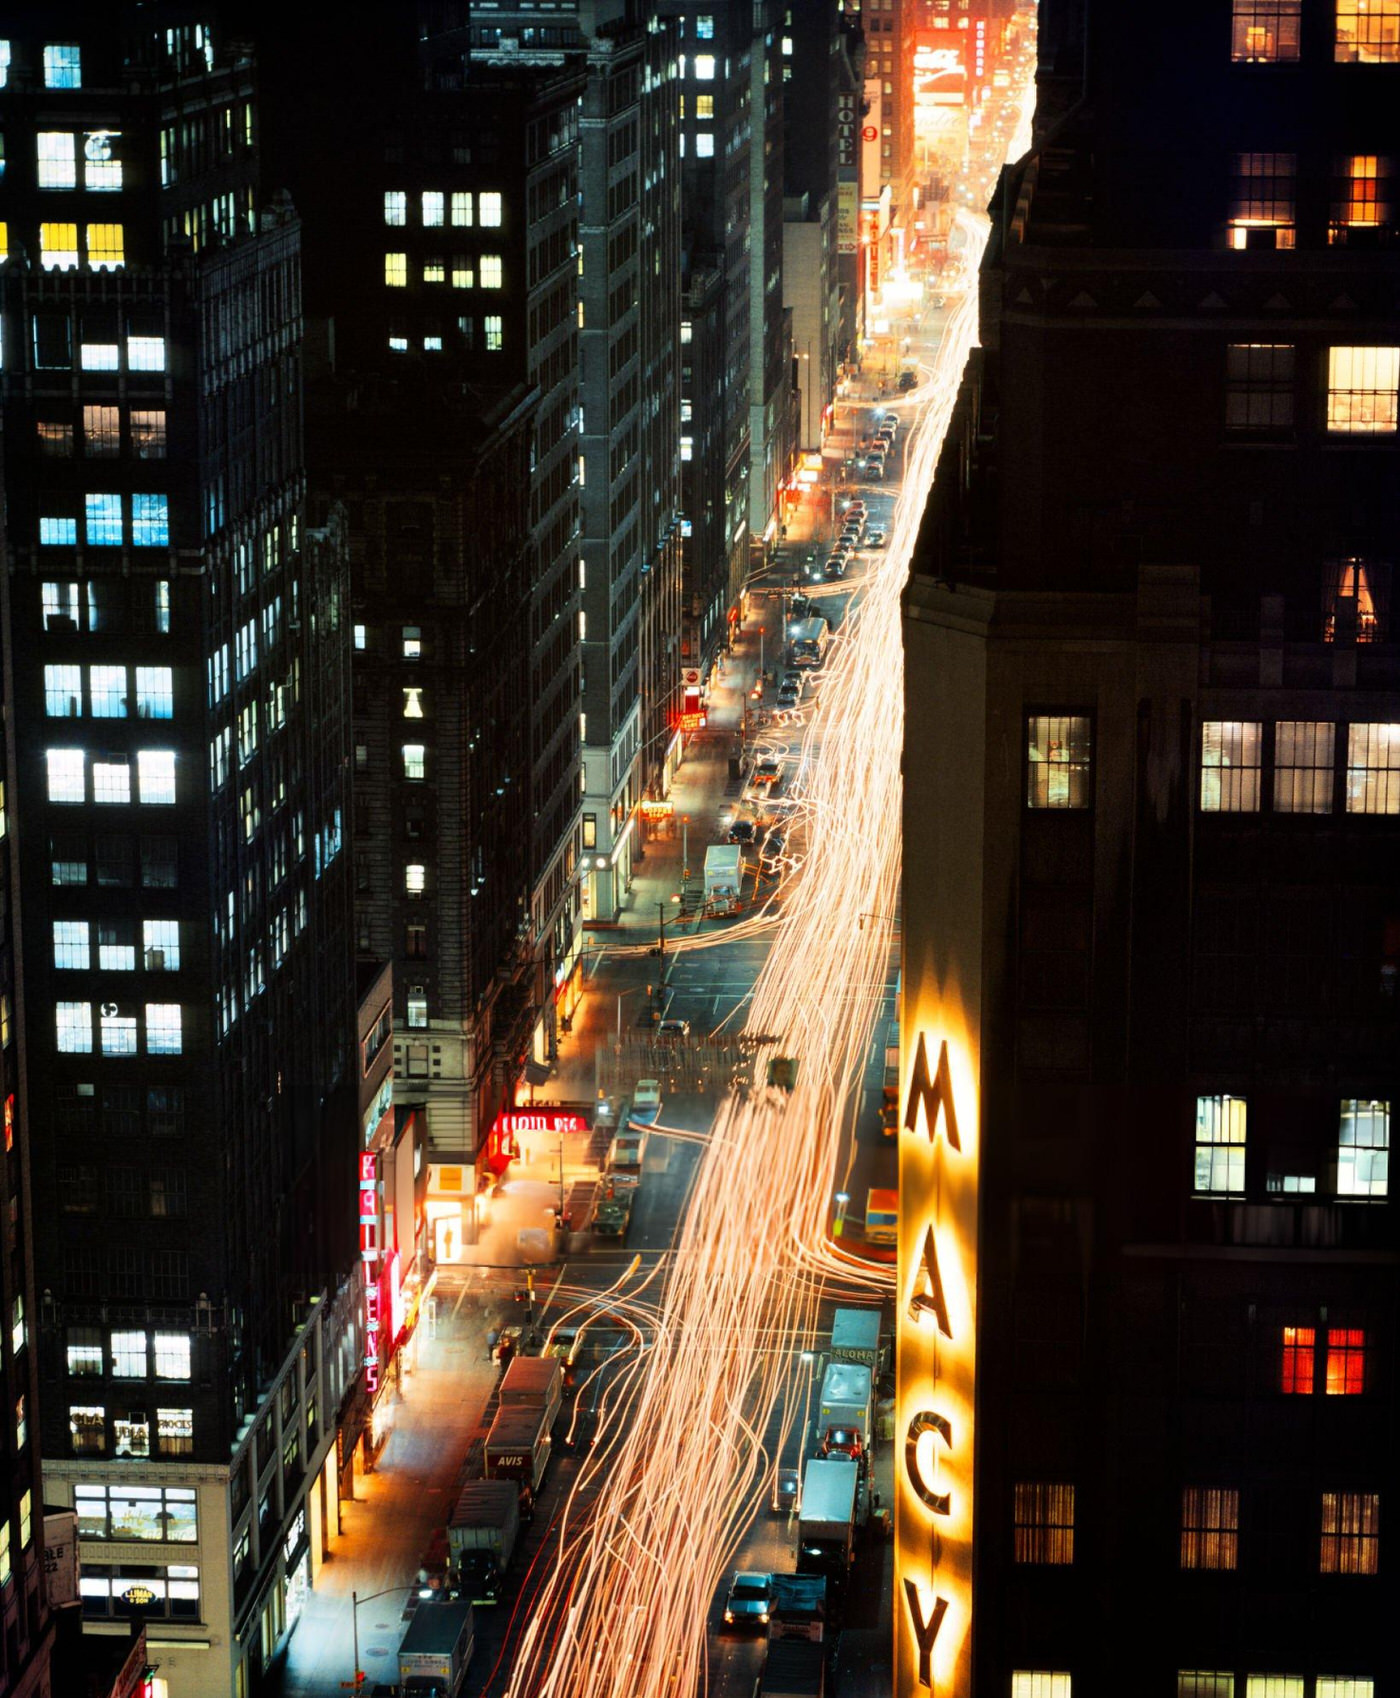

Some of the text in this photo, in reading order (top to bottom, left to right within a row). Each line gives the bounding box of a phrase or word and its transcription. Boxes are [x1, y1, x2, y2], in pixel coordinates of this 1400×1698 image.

[976, 21, 985, 76] HOWARD
[838, 95, 854, 164] HOTEL
[904, 1031, 961, 1688] MACY
[497, 1456, 523, 1466] AVIS
